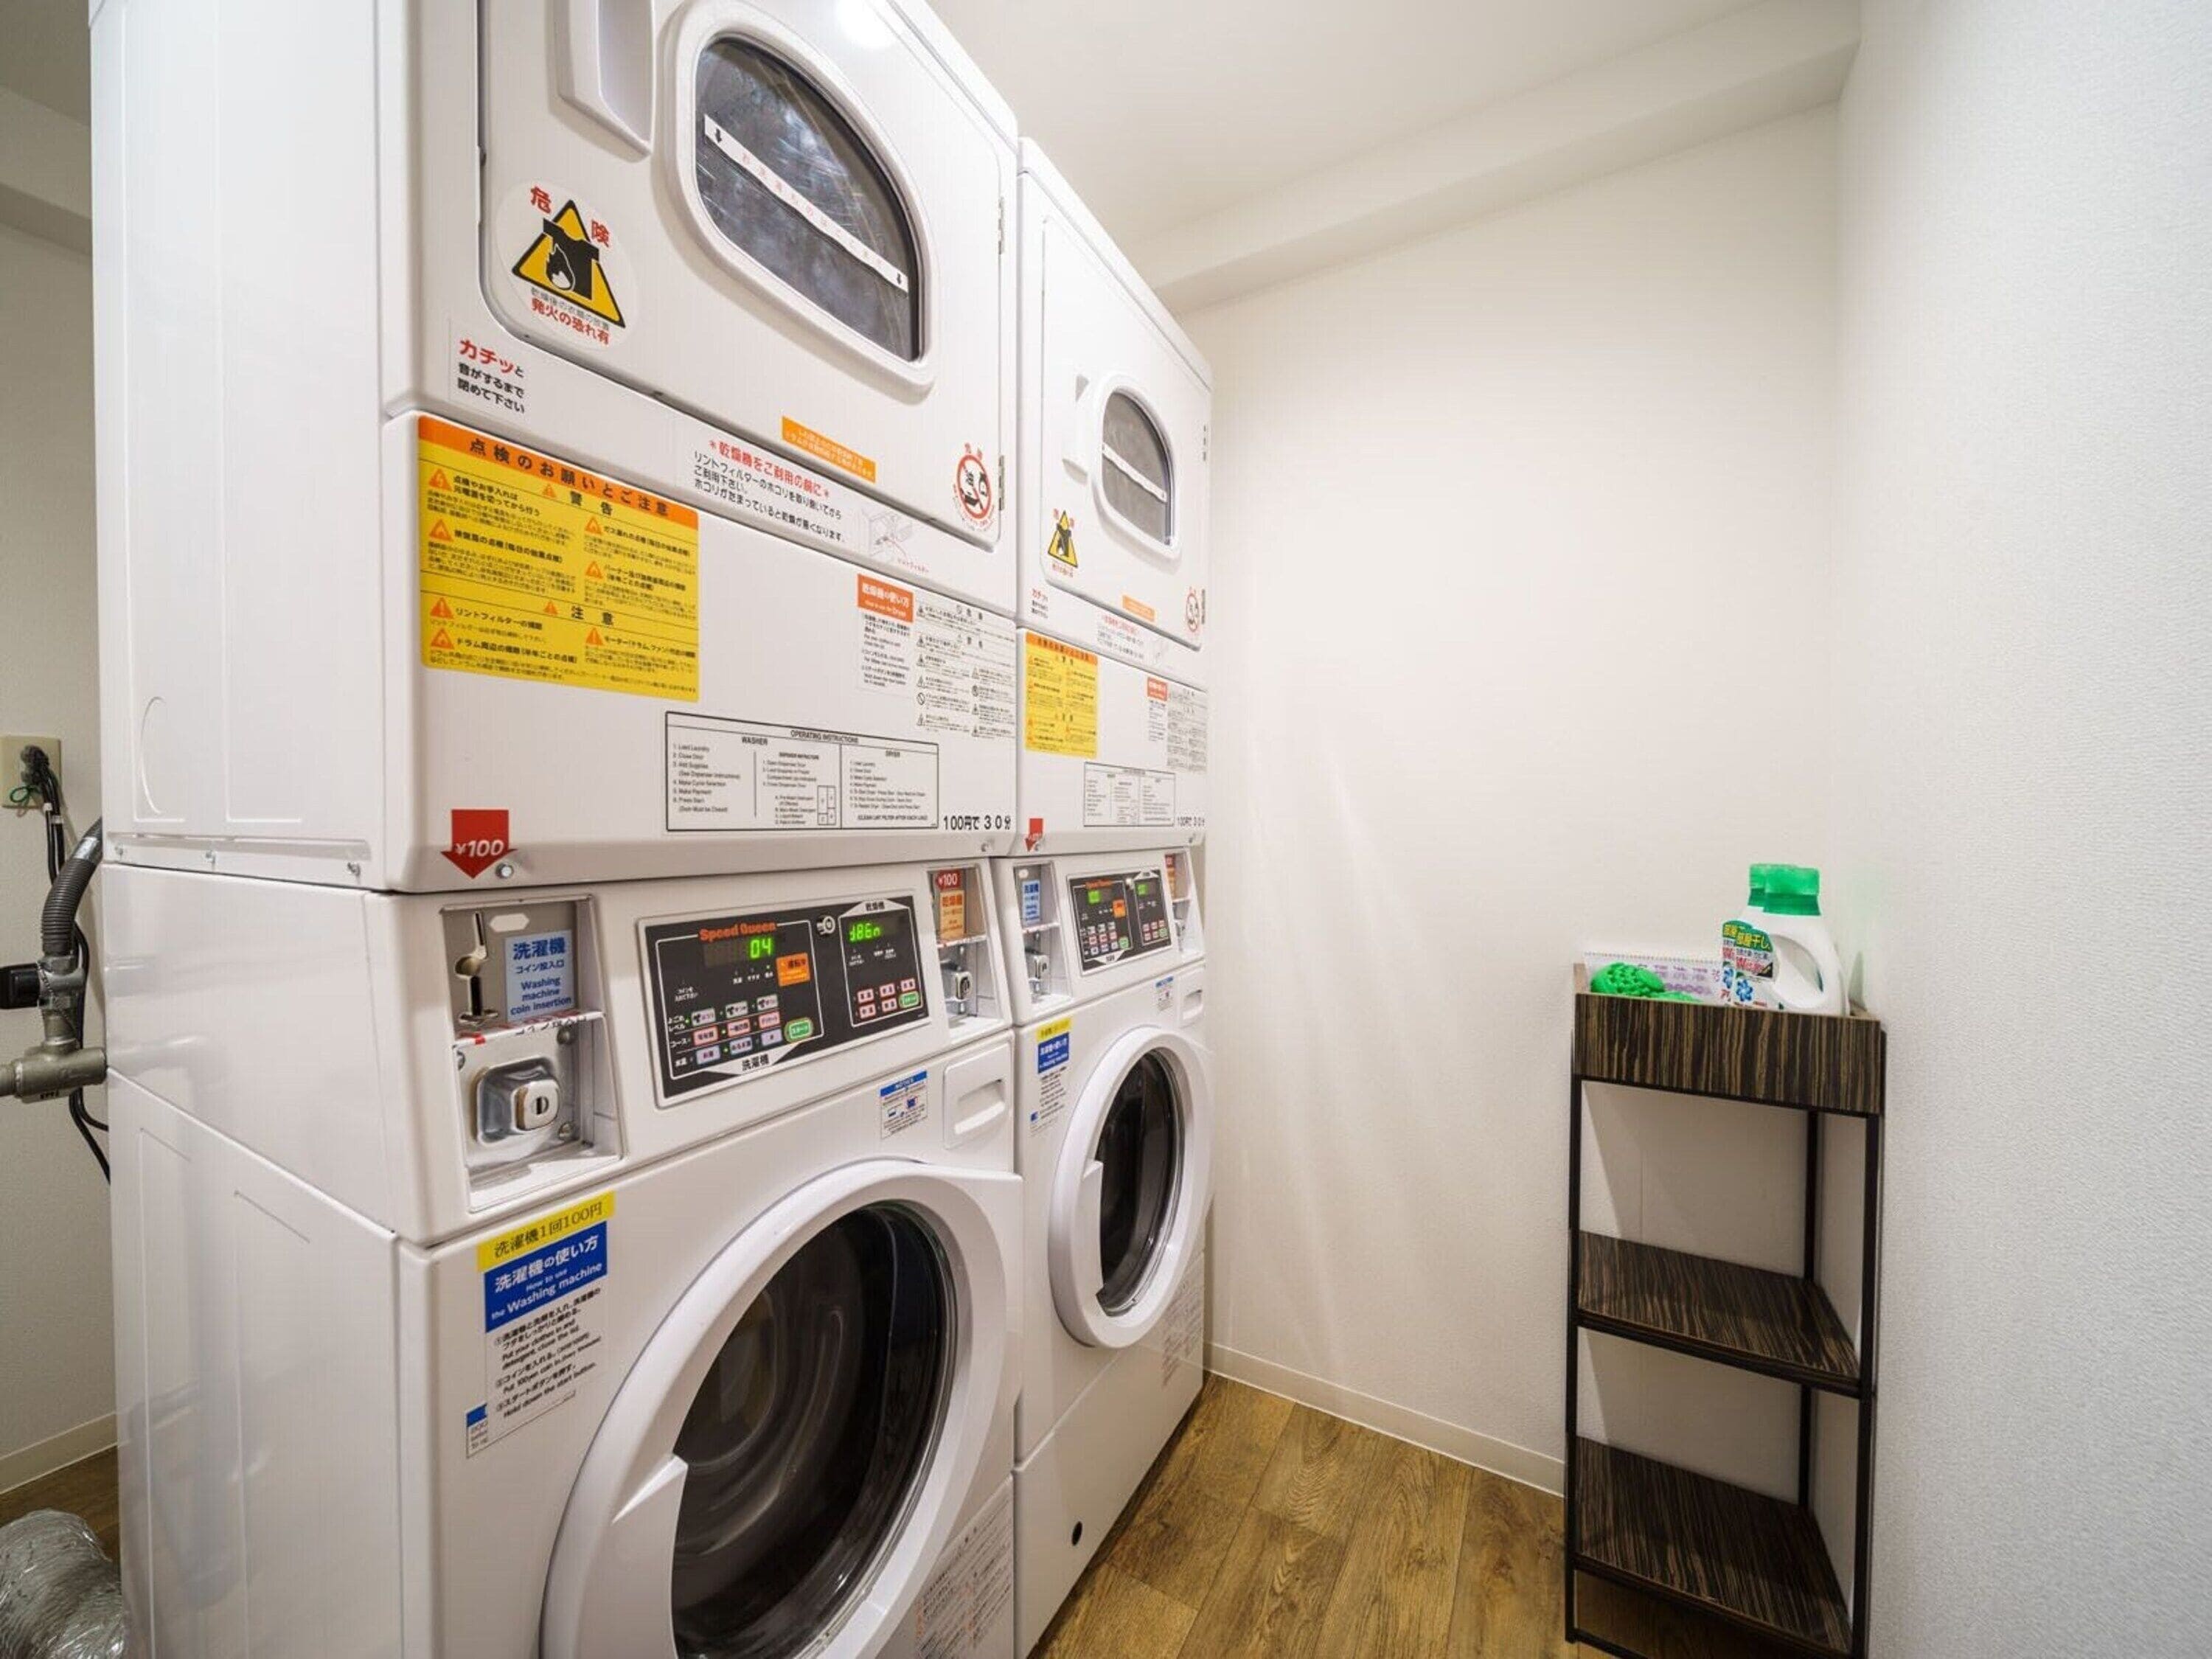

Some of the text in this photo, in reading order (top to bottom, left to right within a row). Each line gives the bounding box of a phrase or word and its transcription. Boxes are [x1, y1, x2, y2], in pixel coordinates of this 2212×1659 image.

[530, 186, 610, 248] 危 険
[532, 298, 610, 345] 発火の恐れ有
[459, 338, 524, 378] カチッと
[458, 362, 525, 398] 音がするまで
[456, 378, 525, 414] 閉めて下さい
[470, 438, 669, 517] 点検のお願いとご注意
[571, 605, 613, 627] 注意
[742, 737, 768, 745] WASHER
[790, 729, 822, 741] OPERATING
[455, 839, 505, 858] ¥100
[700, 921, 776, 942] Speed Queen
[513, 937, 566, 961] 洗濯機
[750, 937, 772, 960] 04
[515, 959, 565, 975] コイン投入口
[521, 975, 560, 992] Washing
[522, 987, 560, 1002] machine
[510, 996, 571, 1016] coin insertion
[494, 1201, 602, 1258] 洗濯機1回100円
[495, 1234, 599, 1294] 洗濯機の使い方
[490, 1262, 603, 1321] the Washing machine
